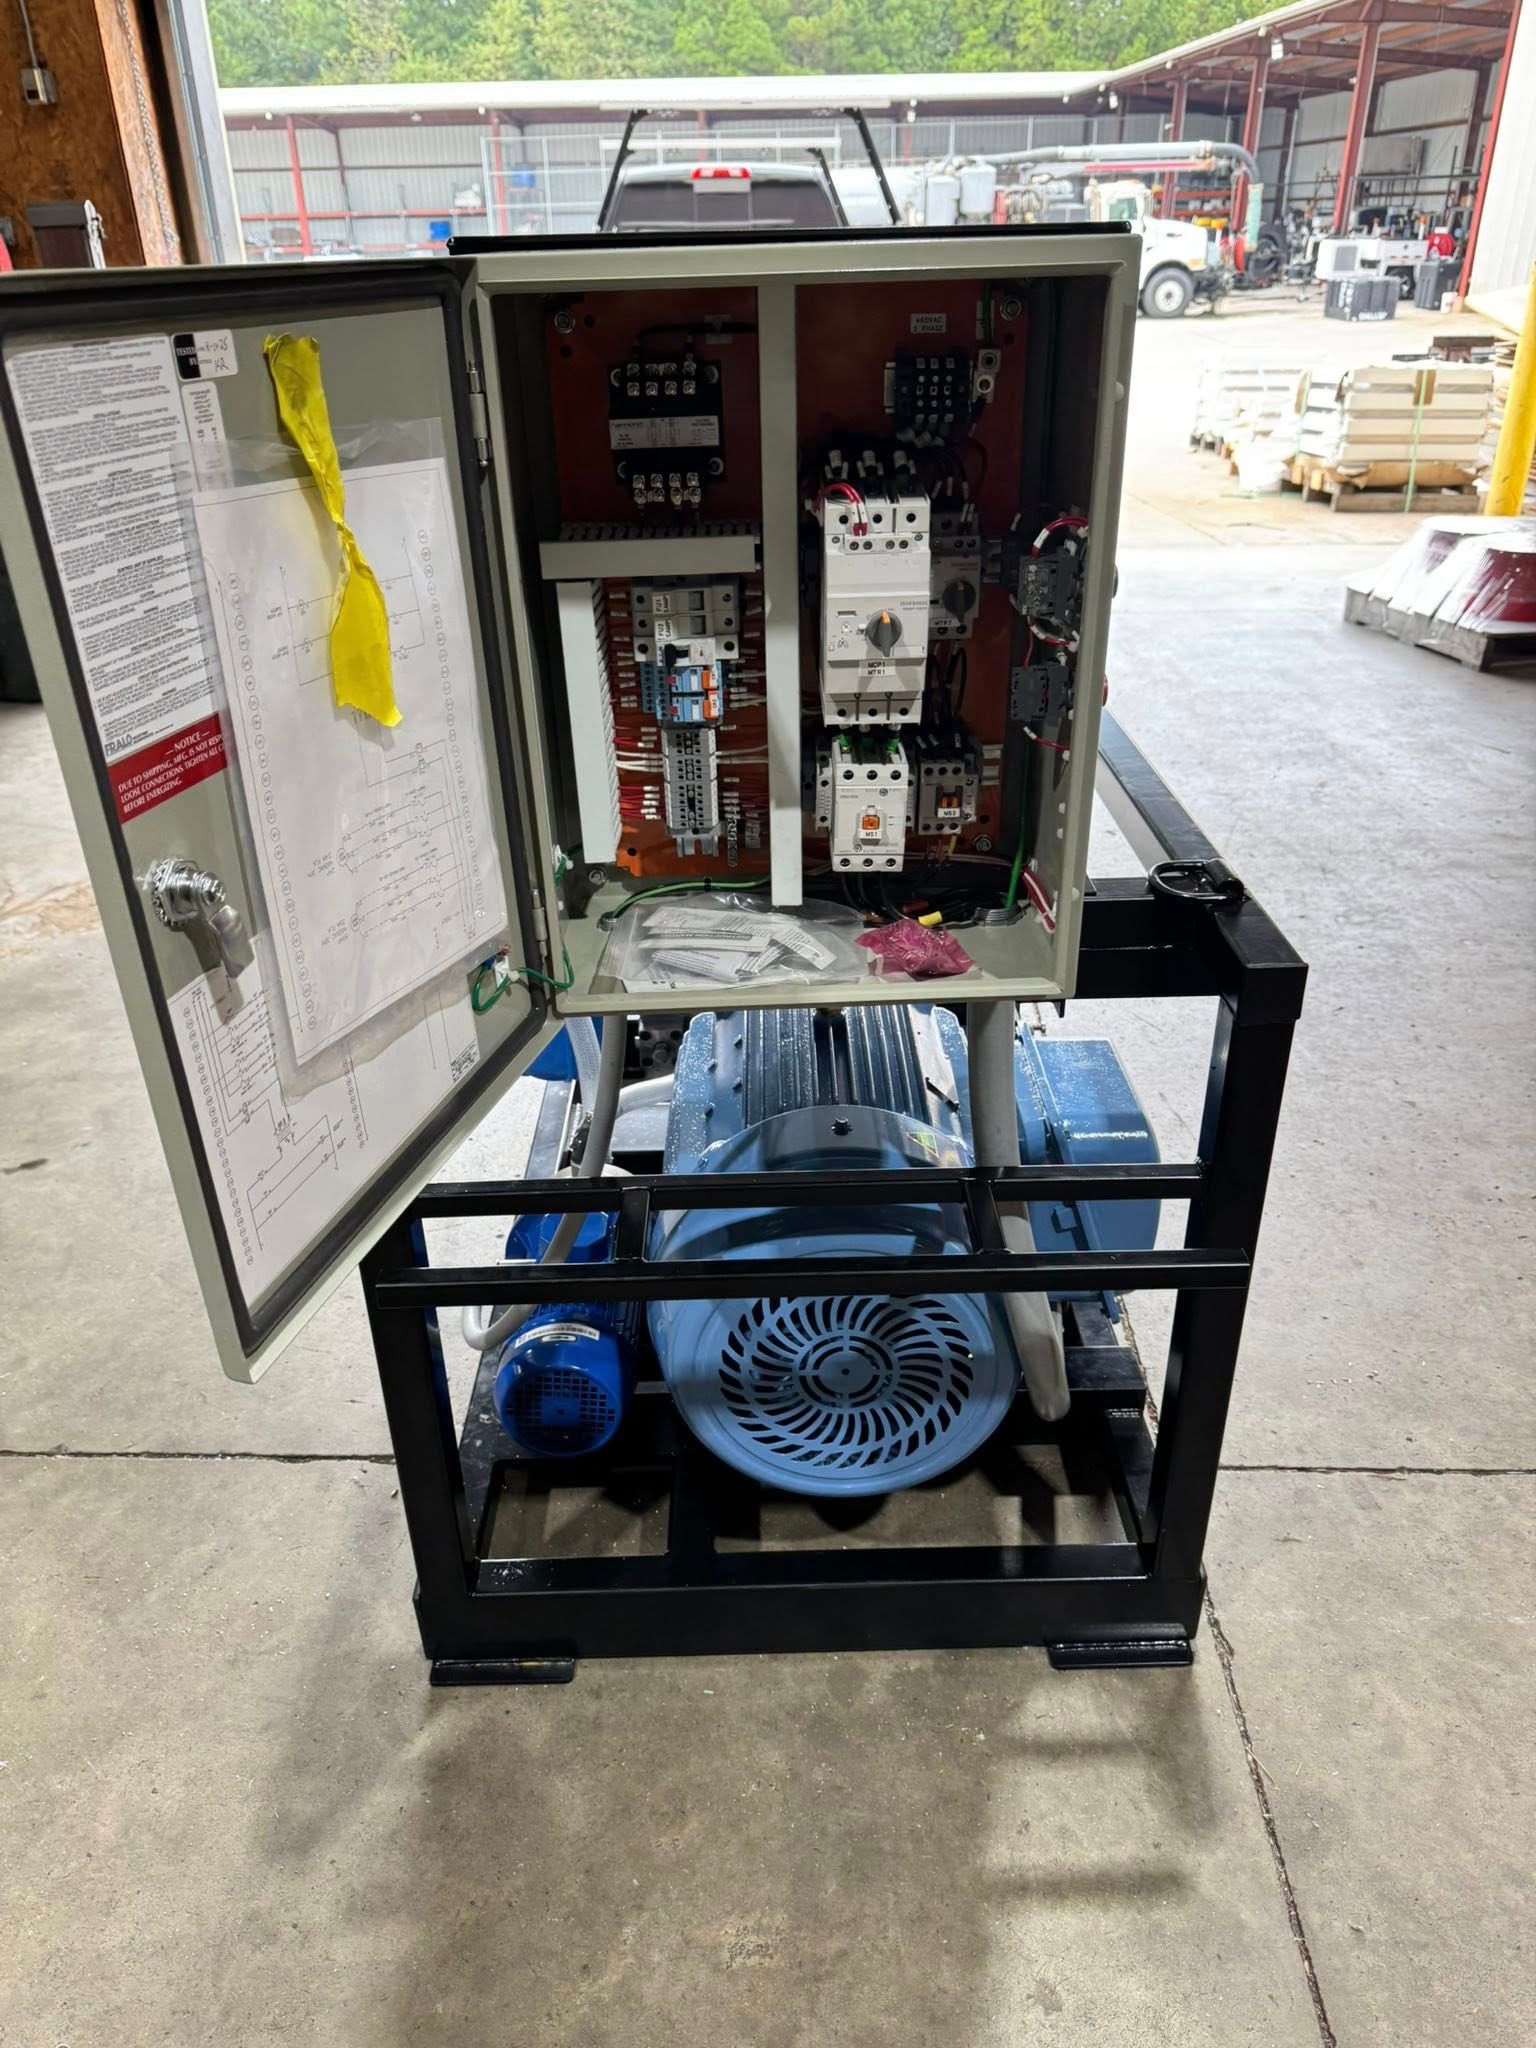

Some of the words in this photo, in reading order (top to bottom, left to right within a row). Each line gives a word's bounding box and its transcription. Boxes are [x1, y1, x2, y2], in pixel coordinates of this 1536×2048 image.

[174, 732, 201, 752] NOTICE
[118, 781, 133, 793] DUE
[133, 776, 142, 786] TO
[195, 742, 209, 754] NOT
[120, 788, 141, 803] LOOSE
[184, 754, 209, 770] TIGHTEN
[208, 749, 218, 758] ALL
[123, 799, 146, 814] BEFORE
